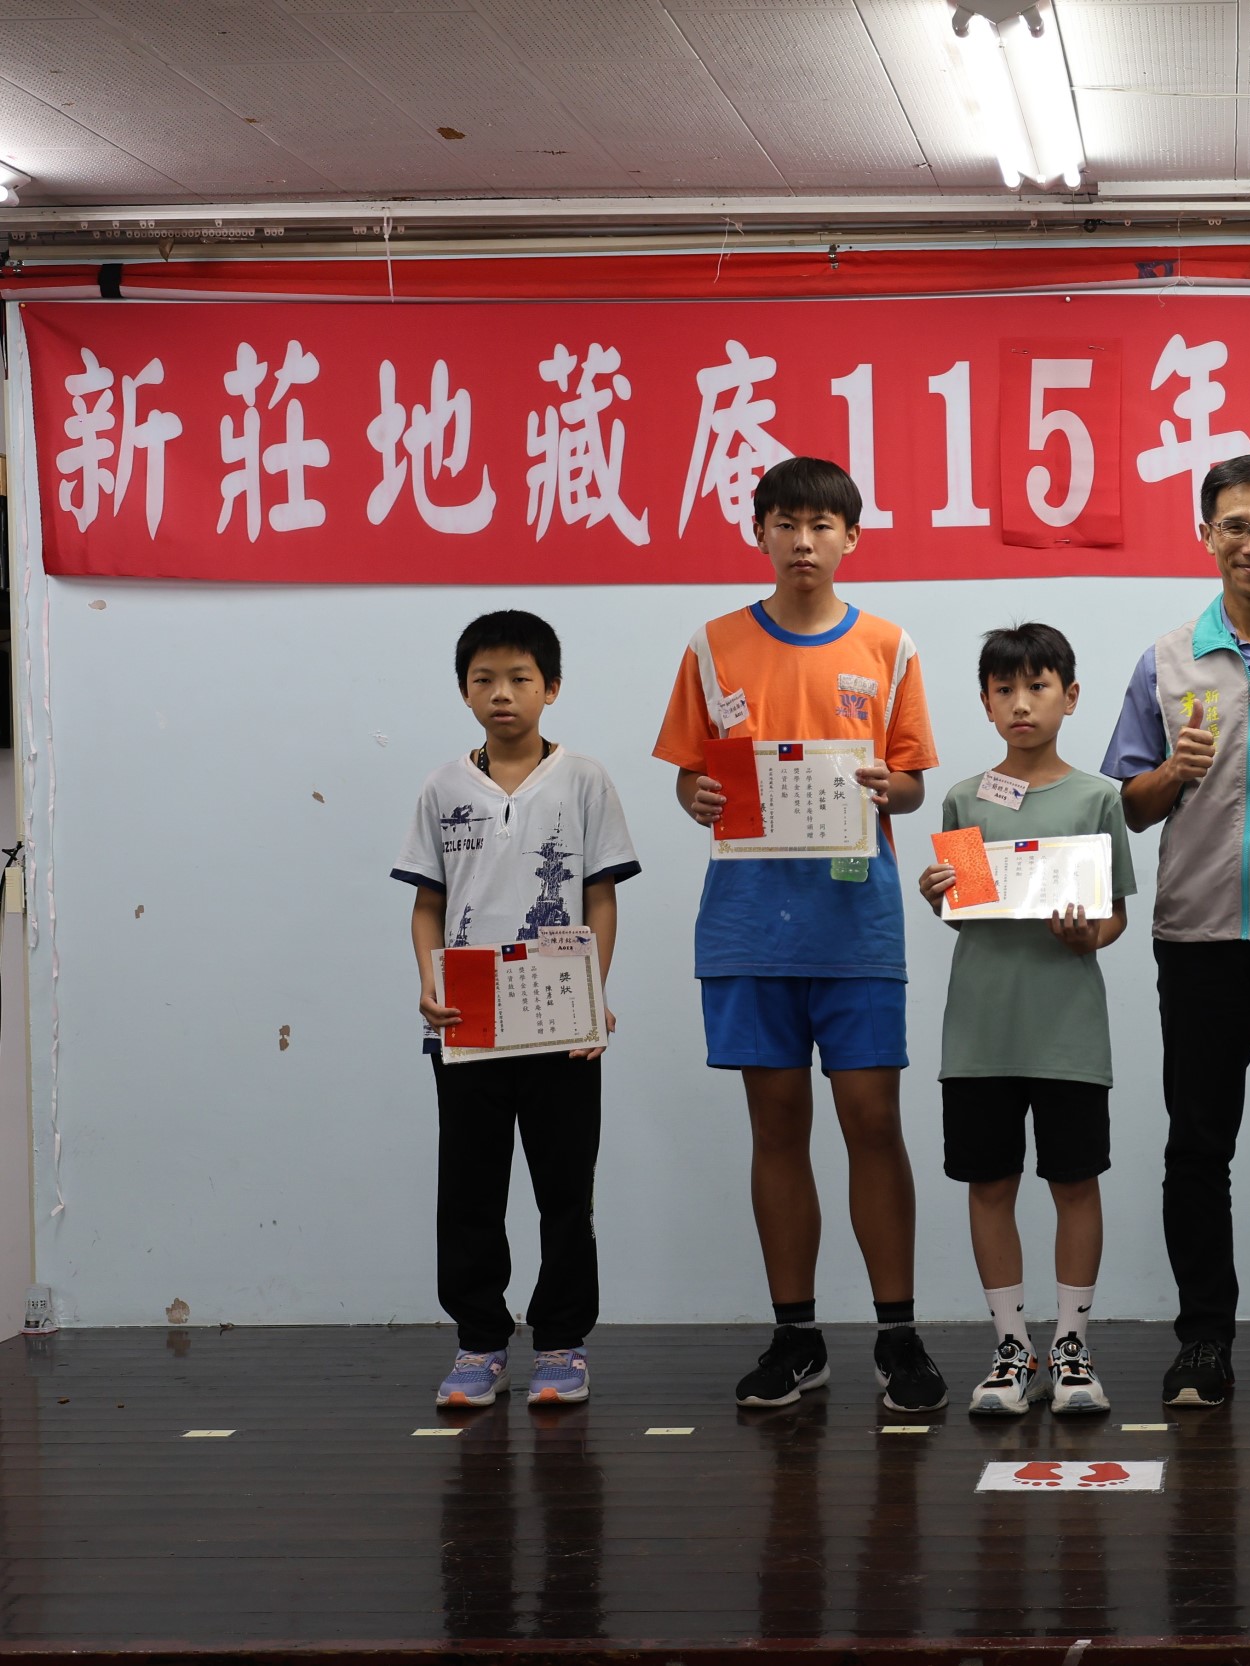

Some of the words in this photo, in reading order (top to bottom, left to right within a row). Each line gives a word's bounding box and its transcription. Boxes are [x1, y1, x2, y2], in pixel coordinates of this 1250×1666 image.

[1205, 690, 1220, 755] 新莊區
[833, 776, 846, 800] 獎狀
[559, 971, 573, 995] 獎狀
